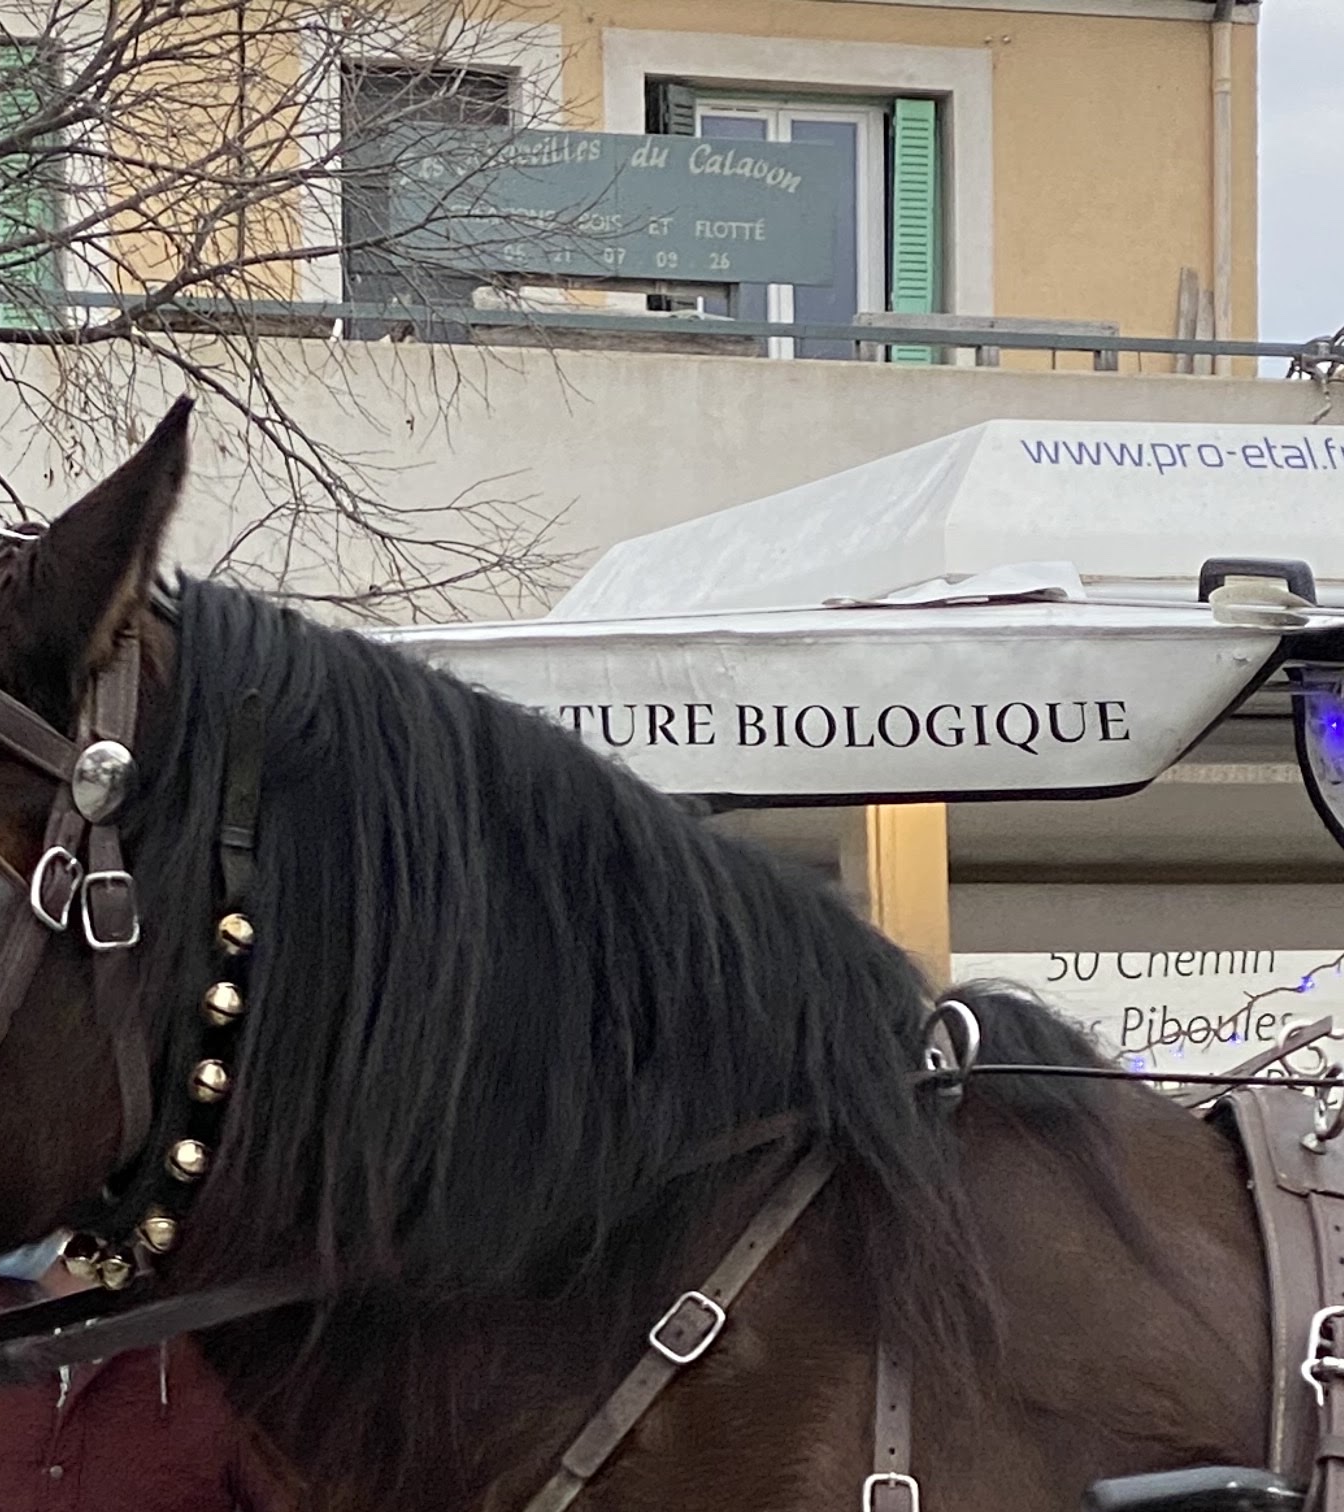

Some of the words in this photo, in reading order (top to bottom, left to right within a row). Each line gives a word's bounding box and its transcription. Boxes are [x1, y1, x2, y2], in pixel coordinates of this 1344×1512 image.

[631, 138, 668, 168] du
[649, 216, 673, 236] ET
[695, 217, 766, 241] FLOTTÉ
[603, 247, 626, 265] 07
[709, 252, 730, 270] 26
[558, 702, 716, 748] TURE
[736, 700, 1131, 755] BIOLOGIQUE
